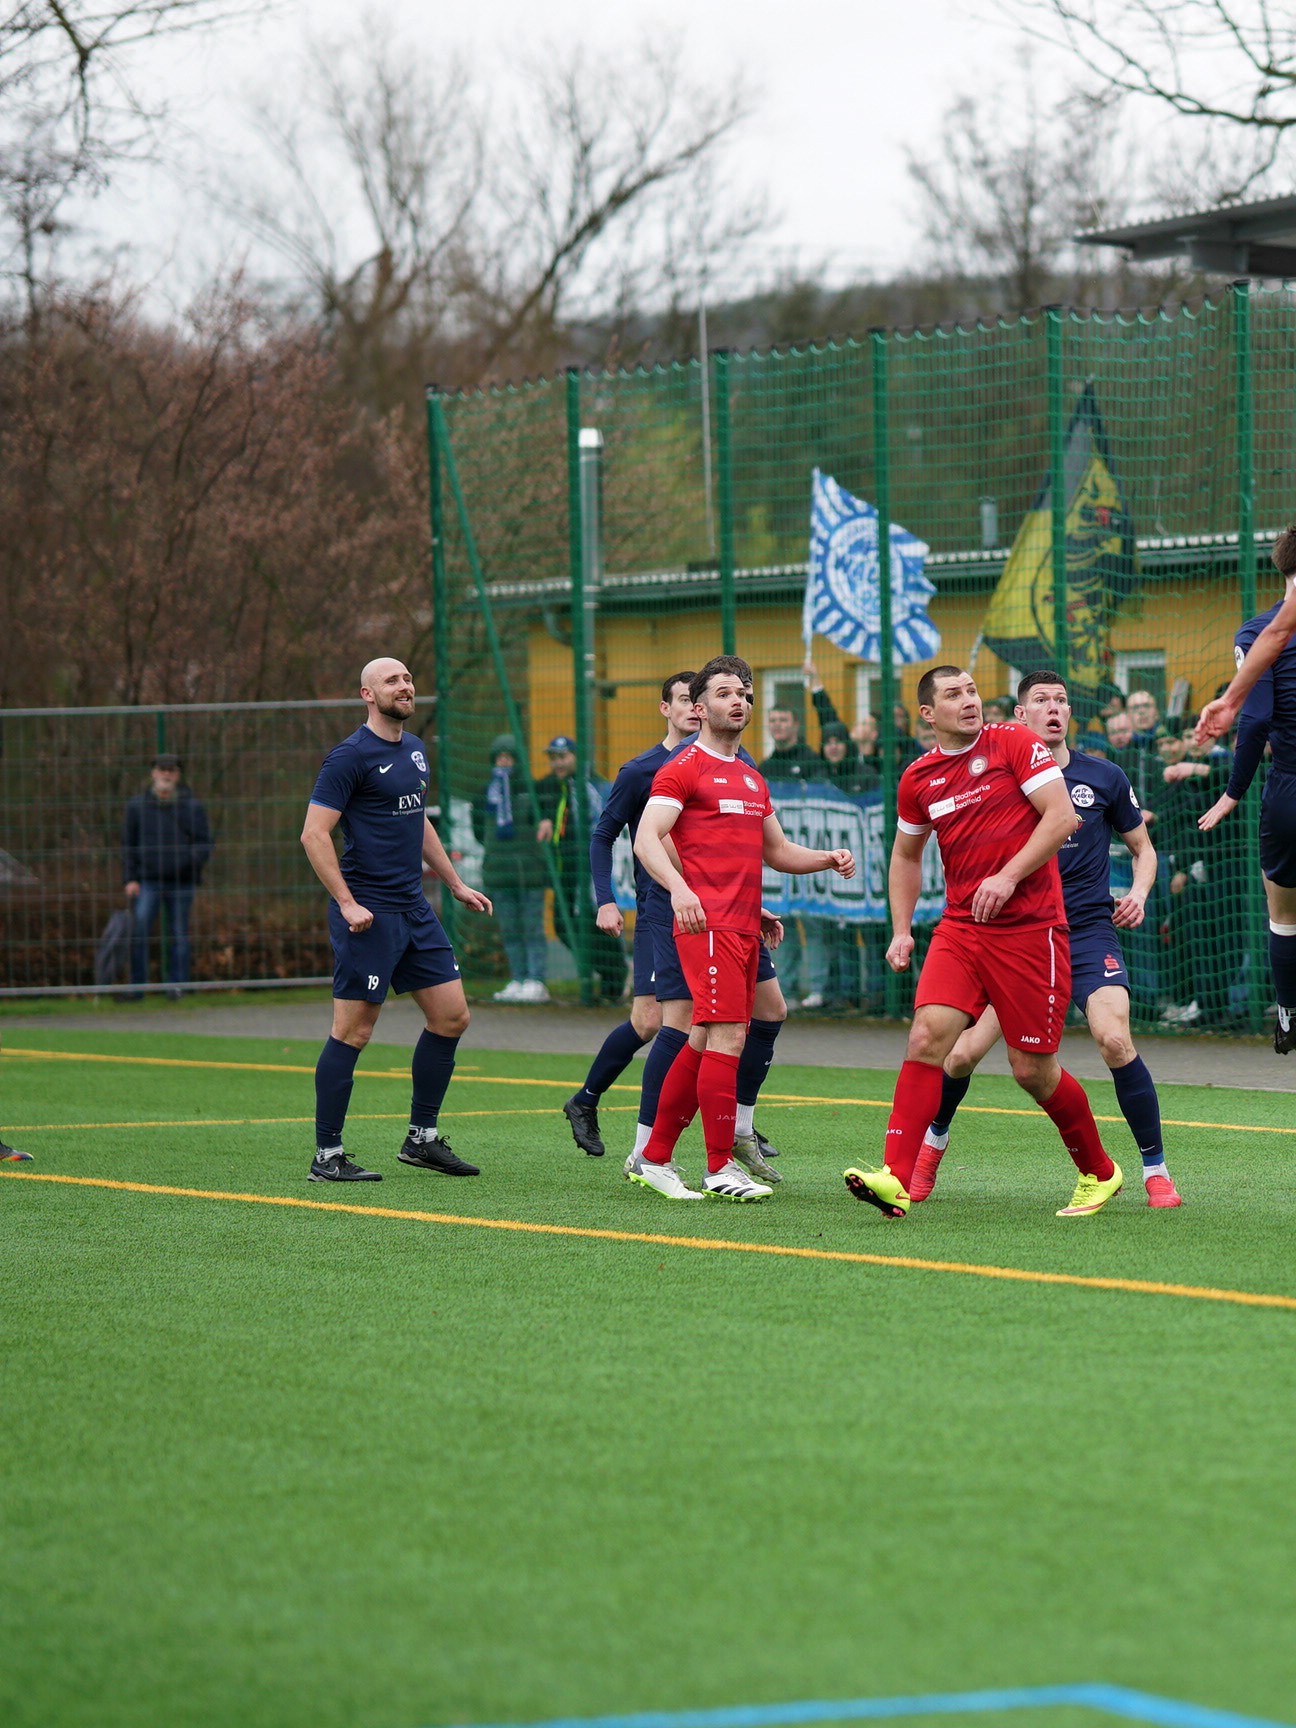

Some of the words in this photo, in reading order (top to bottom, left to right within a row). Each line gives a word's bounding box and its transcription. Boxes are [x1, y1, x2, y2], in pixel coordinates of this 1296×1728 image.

[929, 777, 947, 787] JAKO
[954, 784, 991, 802] Stadtwerke
[399, 793, 421, 809] EVN
[955, 795, 982, 810] Saalfeld
[368, 975, 380, 991] 19
[1020, 1035, 1041, 1044] JAKO
